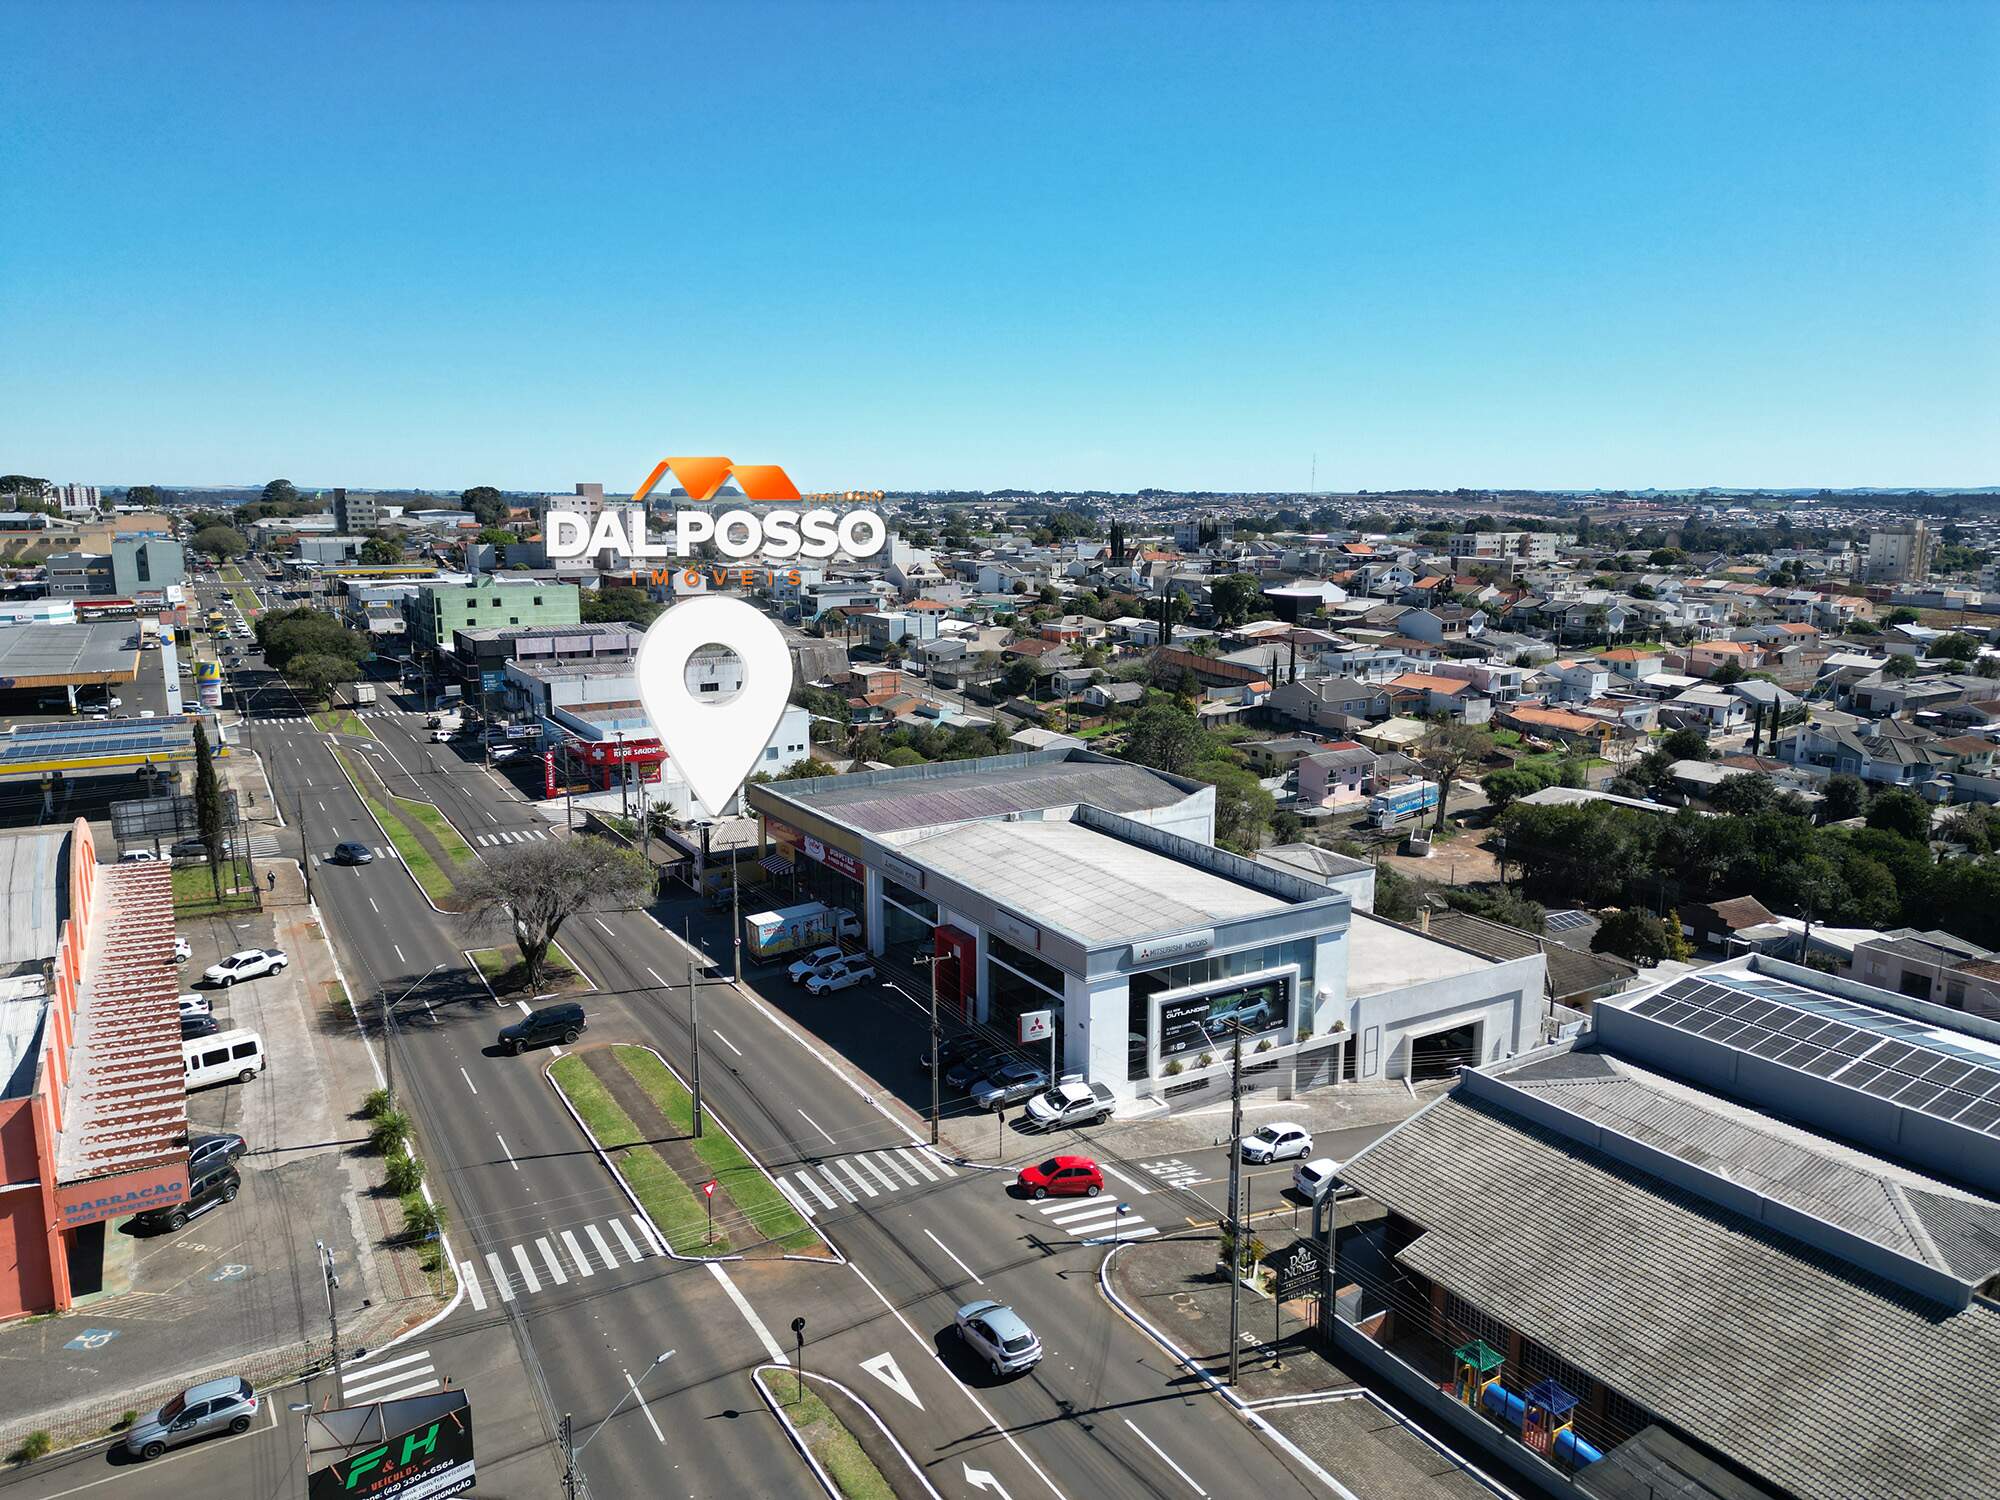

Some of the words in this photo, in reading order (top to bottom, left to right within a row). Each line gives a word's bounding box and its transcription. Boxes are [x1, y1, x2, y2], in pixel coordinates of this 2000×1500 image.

[1150, 943, 1183, 956] MITSUBISHI
[1185, 937, 1208, 950] MOTORS
[1166, 1004, 1210, 1019] OUTLANDER
[64, 1181, 183, 1215] BARRACÃO
[66, 1211, 97, 1224] DOS
[100, 1193, 182, 1217] PRESENTES
[1289, 1251, 1312, 1267] DOM
[345, 1445, 389, 1490] F
[381, 1459, 395, 1473] &
[400, 1423, 440, 1466] H
[383, 1482, 402, 1496] (42)
[402, 1458, 455, 1487] 3304-6564
